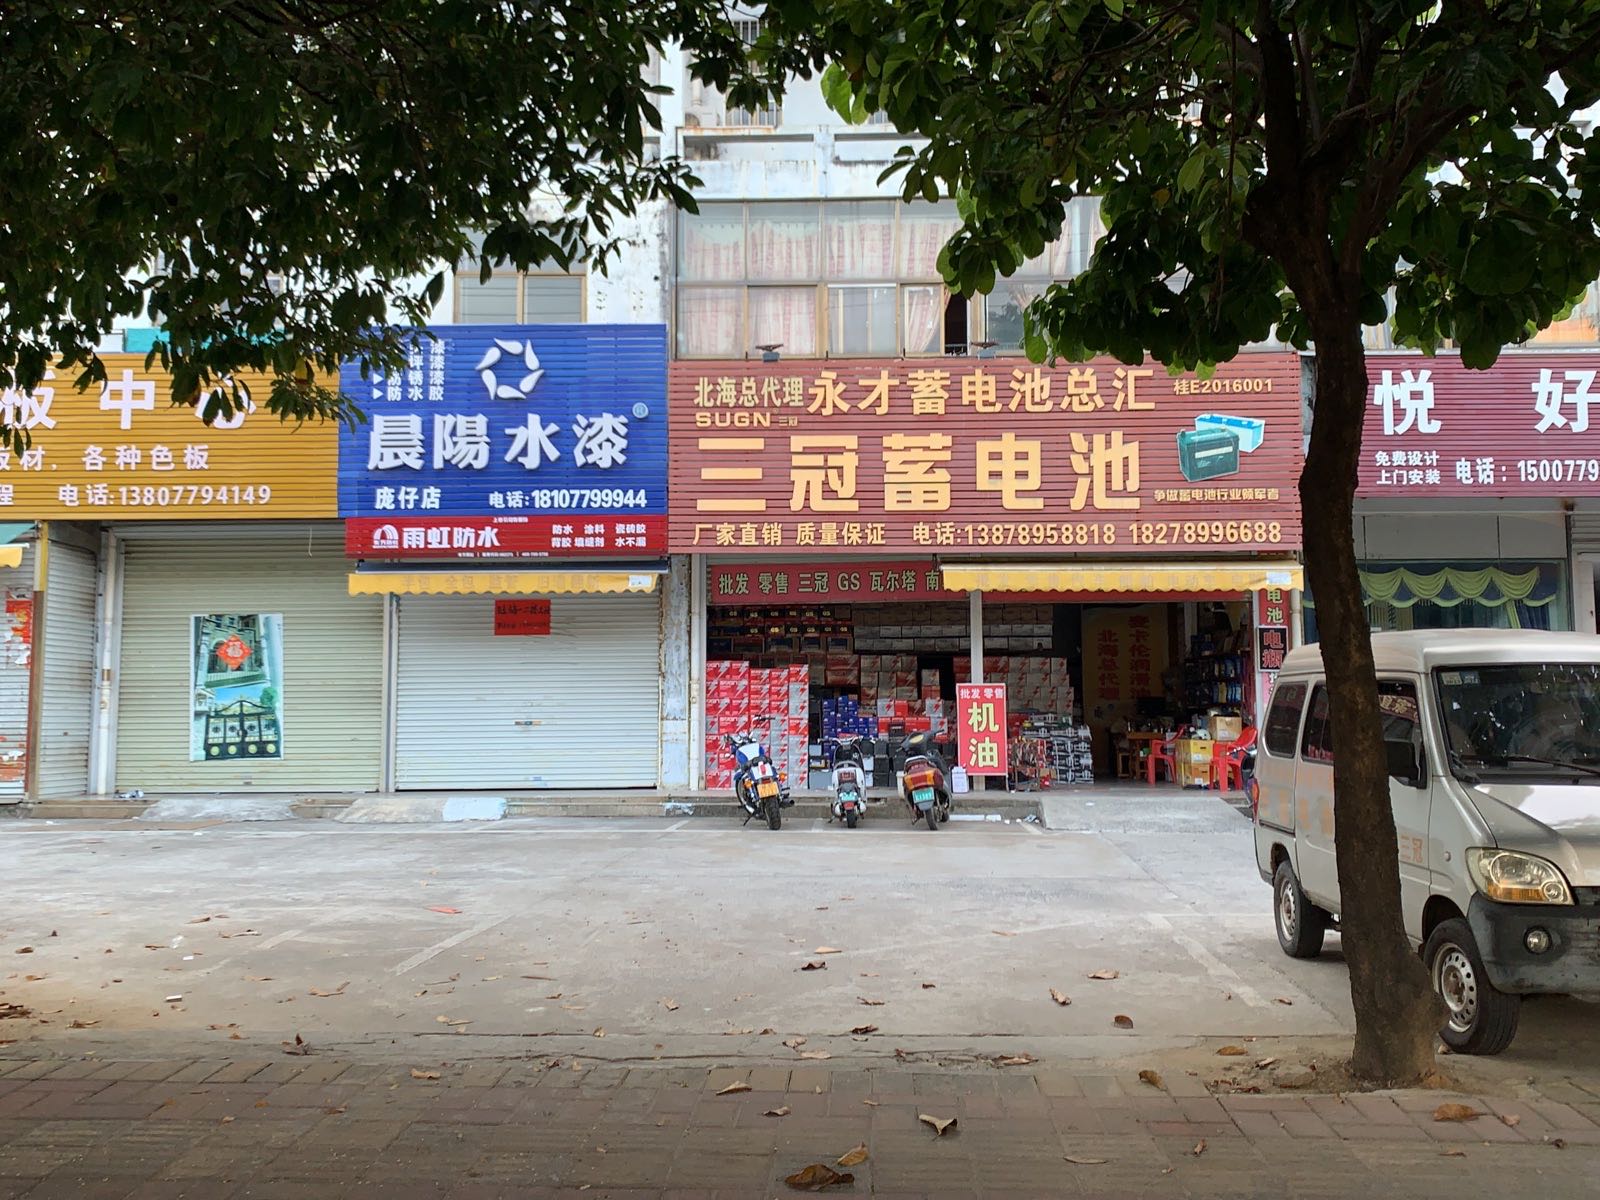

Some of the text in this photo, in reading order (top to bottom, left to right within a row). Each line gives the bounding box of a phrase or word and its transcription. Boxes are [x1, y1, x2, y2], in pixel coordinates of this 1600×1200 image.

[387, 386, 444, 401] 防水胶
[694, 376, 804, 407] 北海总代理
[807, 367, 1156, 415] 永才蓄电池总汇
[1173, 379, 1273, 395] 桂E2016001
[695, 412, 771, 427] SUGN
[367, 413, 629, 470] 晨陽水漆
[1375, 451, 1440, 466] 免费设计
[696, 431, 1141, 512] 三冠蓄电池
[1376, 470, 1441, 485] 上门安装
[402, 526, 500, 549] 雨虹防水
[692, 522, 782, 546] 厂家直销
[796, 521, 886, 546] 质量保证
[1129, 521, 1282, 545] 18278996688
[719, 573, 749, 594] 批发
[758, 572, 789, 594] 零售
[798, 572, 829, 593] 三冠
[837, 572, 860, 591] GS
[869, 571, 915, 592] 瓦尔塔
[1267, 588, 1283, 623] 电池
[960, 688, 980, 699] 批发
[968, 702, 1000, 768] 机油
